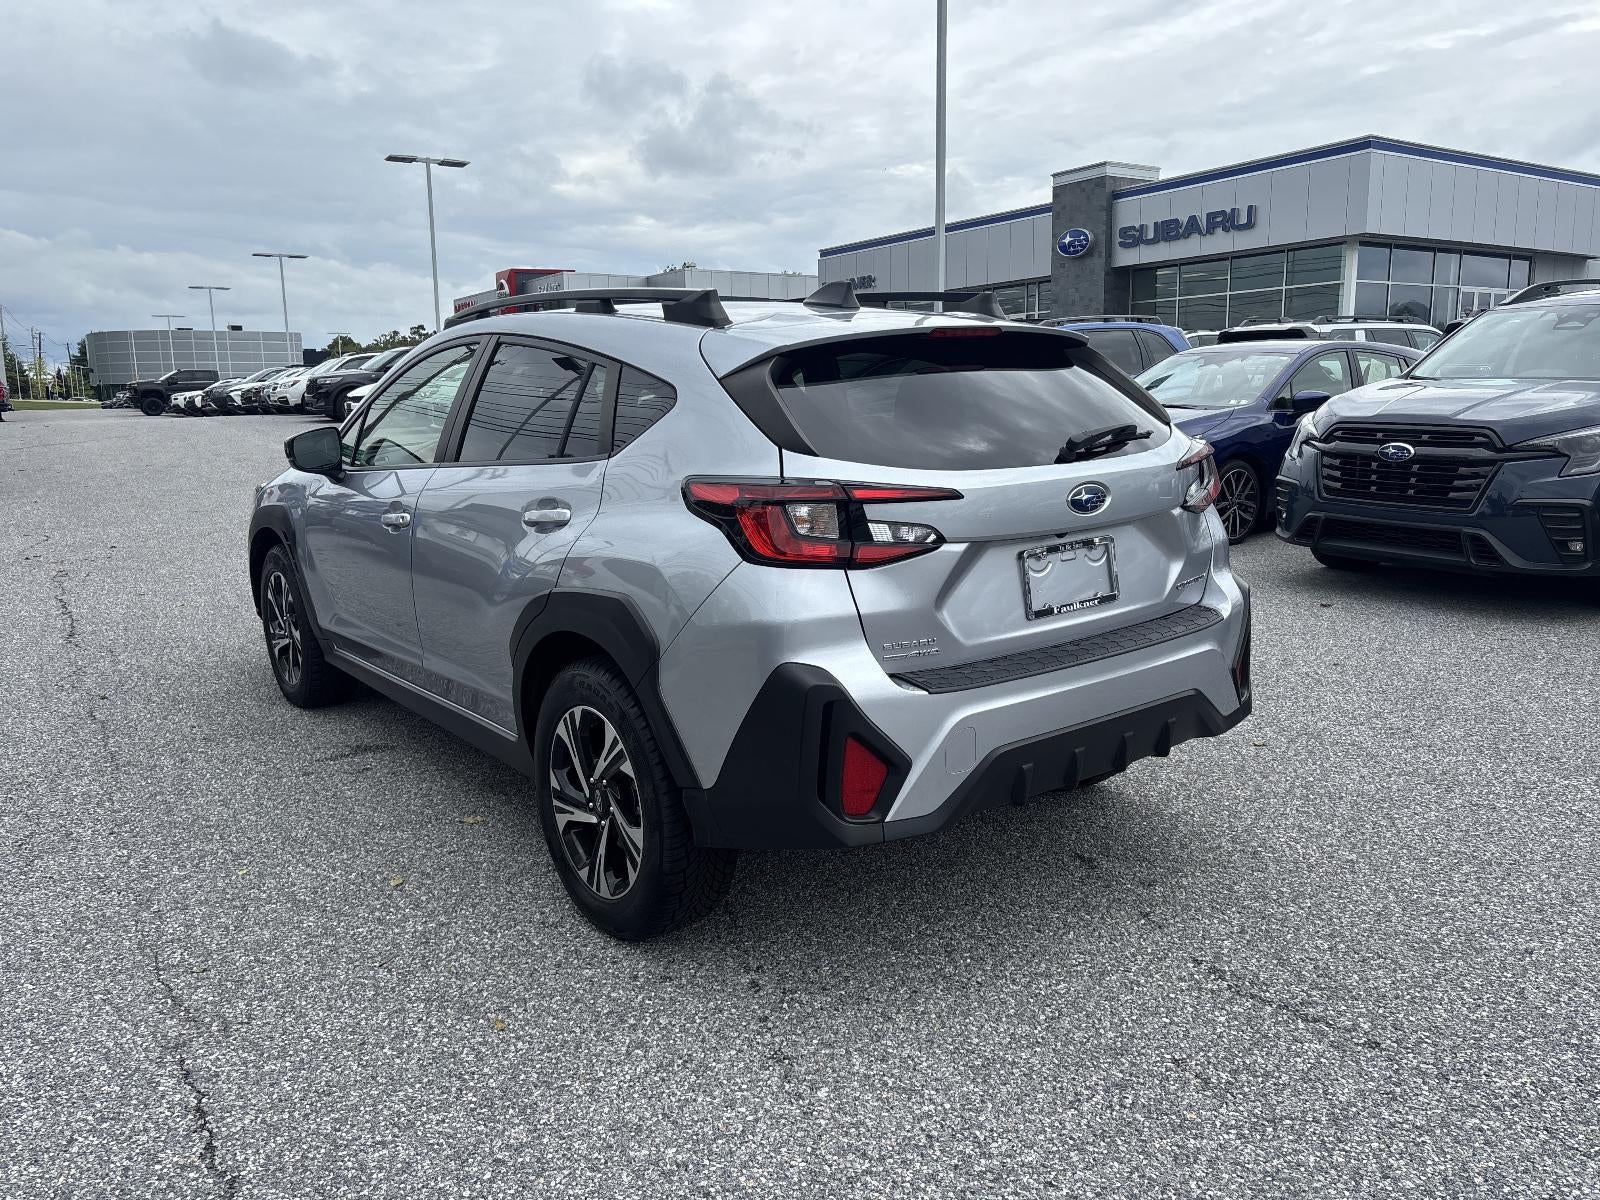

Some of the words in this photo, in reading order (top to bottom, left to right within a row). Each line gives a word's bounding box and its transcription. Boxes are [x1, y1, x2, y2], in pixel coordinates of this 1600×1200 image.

[1118, 204, 1257, 249] SUBARU
[1053, 598, 1101, 614] Faulkner
[882, 637, 937, 651] SUBARU
